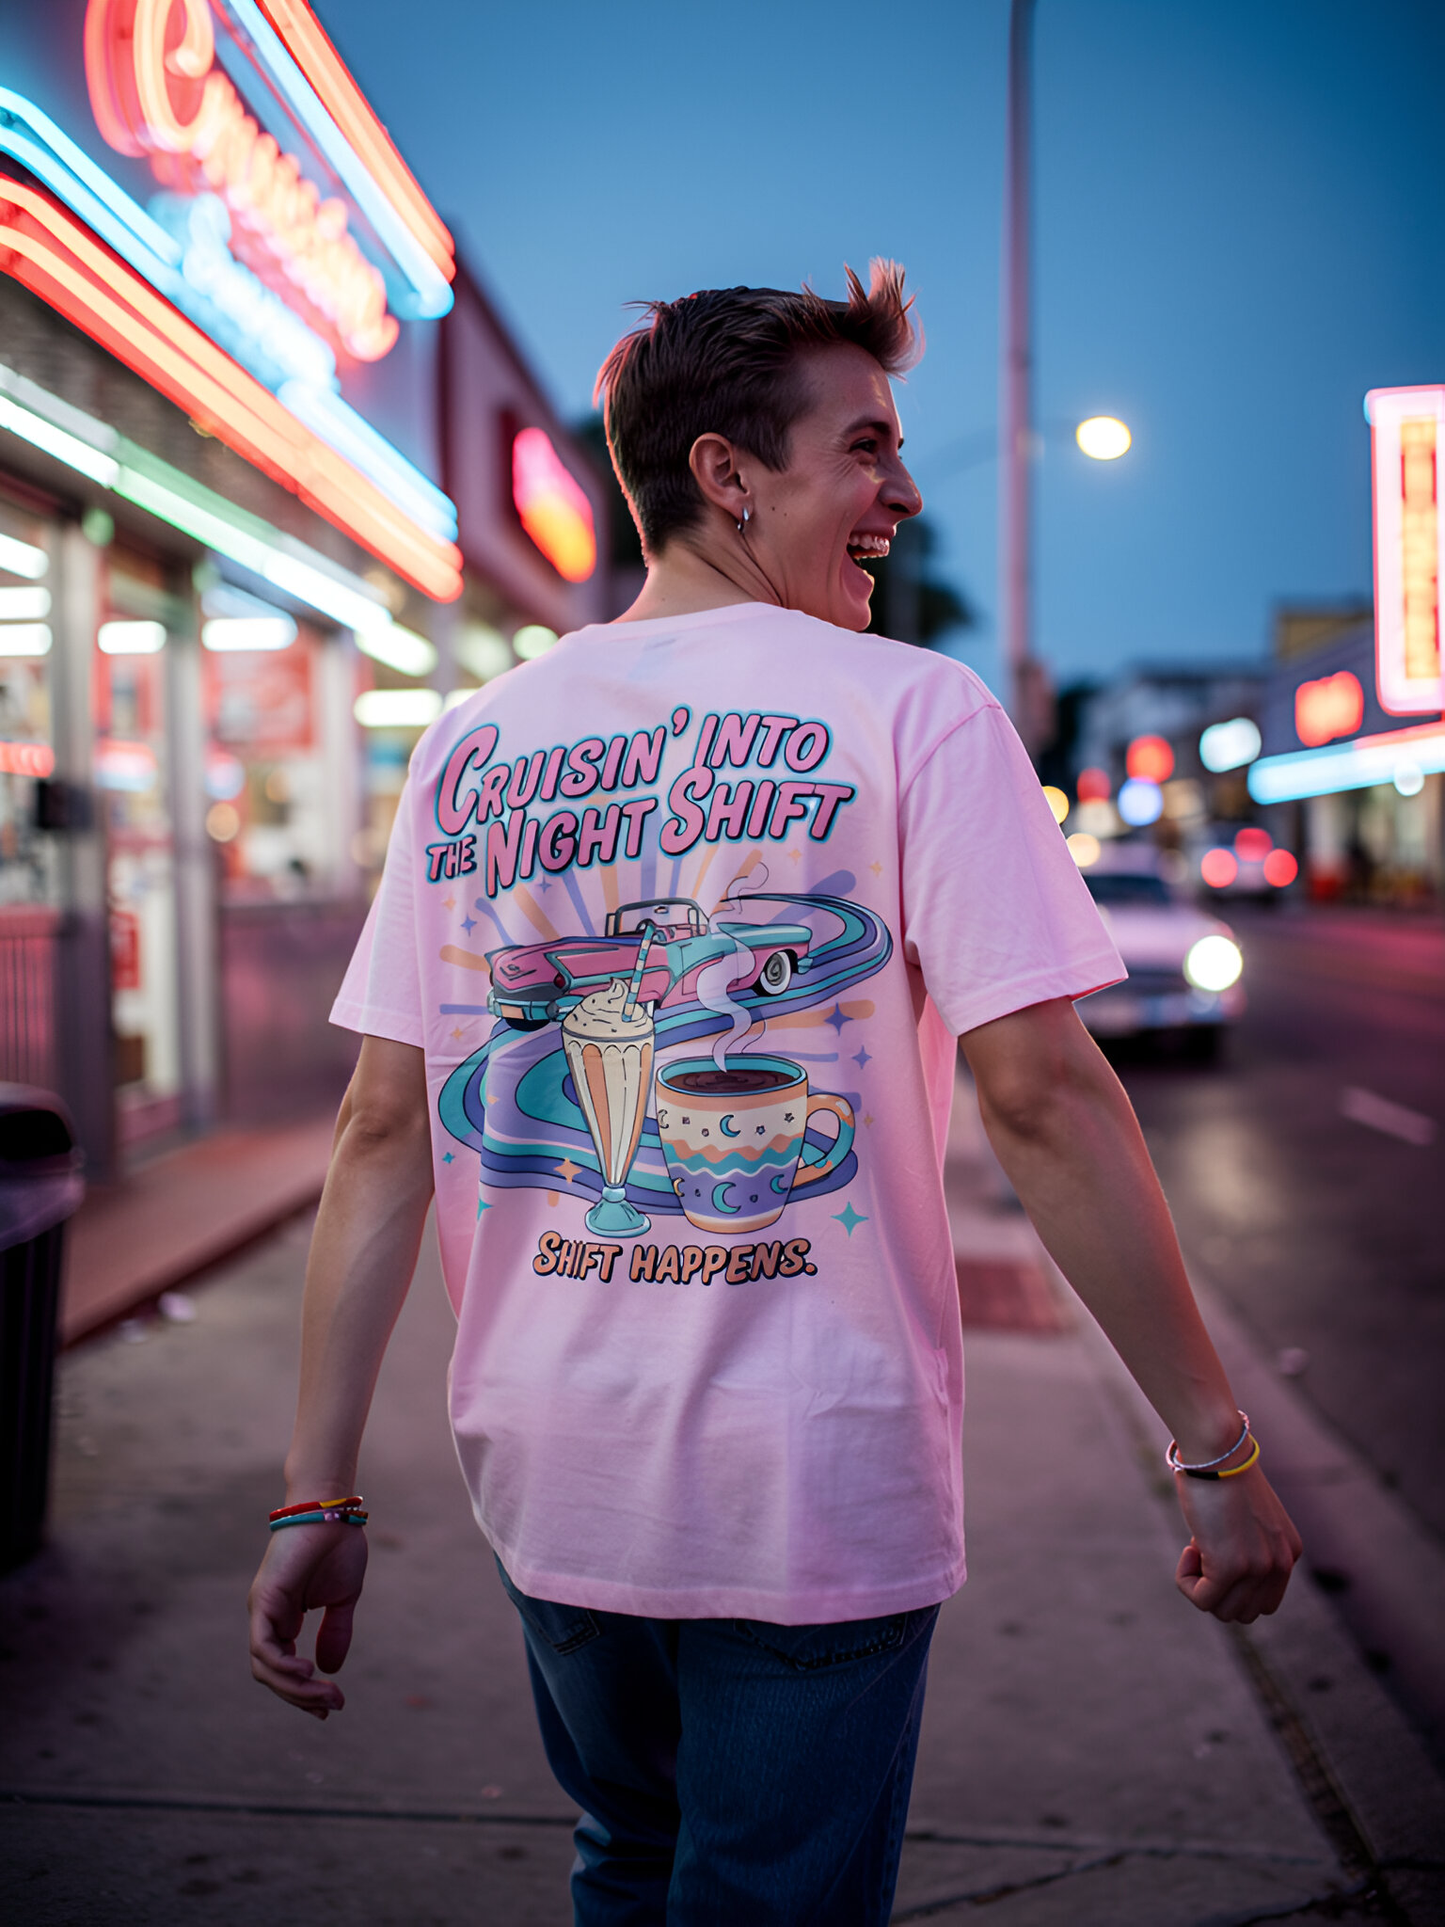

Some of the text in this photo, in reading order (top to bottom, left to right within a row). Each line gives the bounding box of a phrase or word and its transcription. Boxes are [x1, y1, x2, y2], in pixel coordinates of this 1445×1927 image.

[695, 711, 830, 774] INTO
[427, 766, 856, 898] THE NIGHT SHIFT
[533, 1231, 818, 1285] SHIFT HAPPENS.
